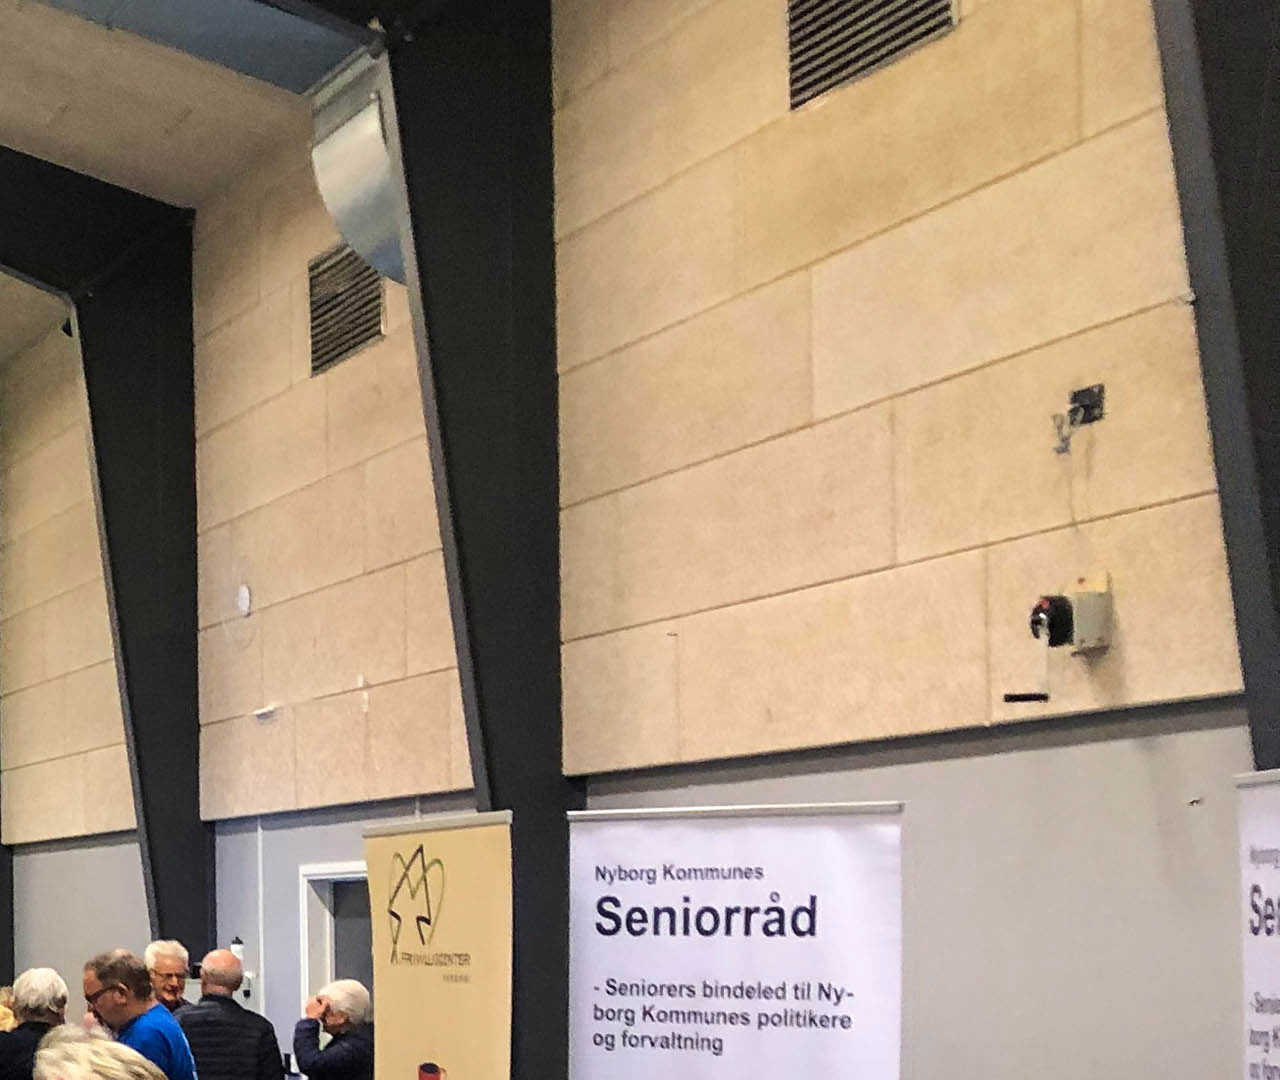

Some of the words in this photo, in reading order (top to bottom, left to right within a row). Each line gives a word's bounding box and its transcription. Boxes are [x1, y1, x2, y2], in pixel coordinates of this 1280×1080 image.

[595, 864, 657, 885] Nyborg
[663, 863, 765, 881] Kommunes
[595, 891, 818, 937] Seniorråd
[606, 978, 697, 999] Seniorers
[702, 980, 787, 1001] bindeled
[793, 982, 812, 1001] til
[818, 982, 855, 1007] Ny-
[593, 1004, 636, 1027] borg
[642, 1004, 751, 1026] Kommunes
[757, 1007, 853, 1031] politikere
[593, 1031, 616, 1051] og
[621, 1030, 724, 1057] forvaltning
